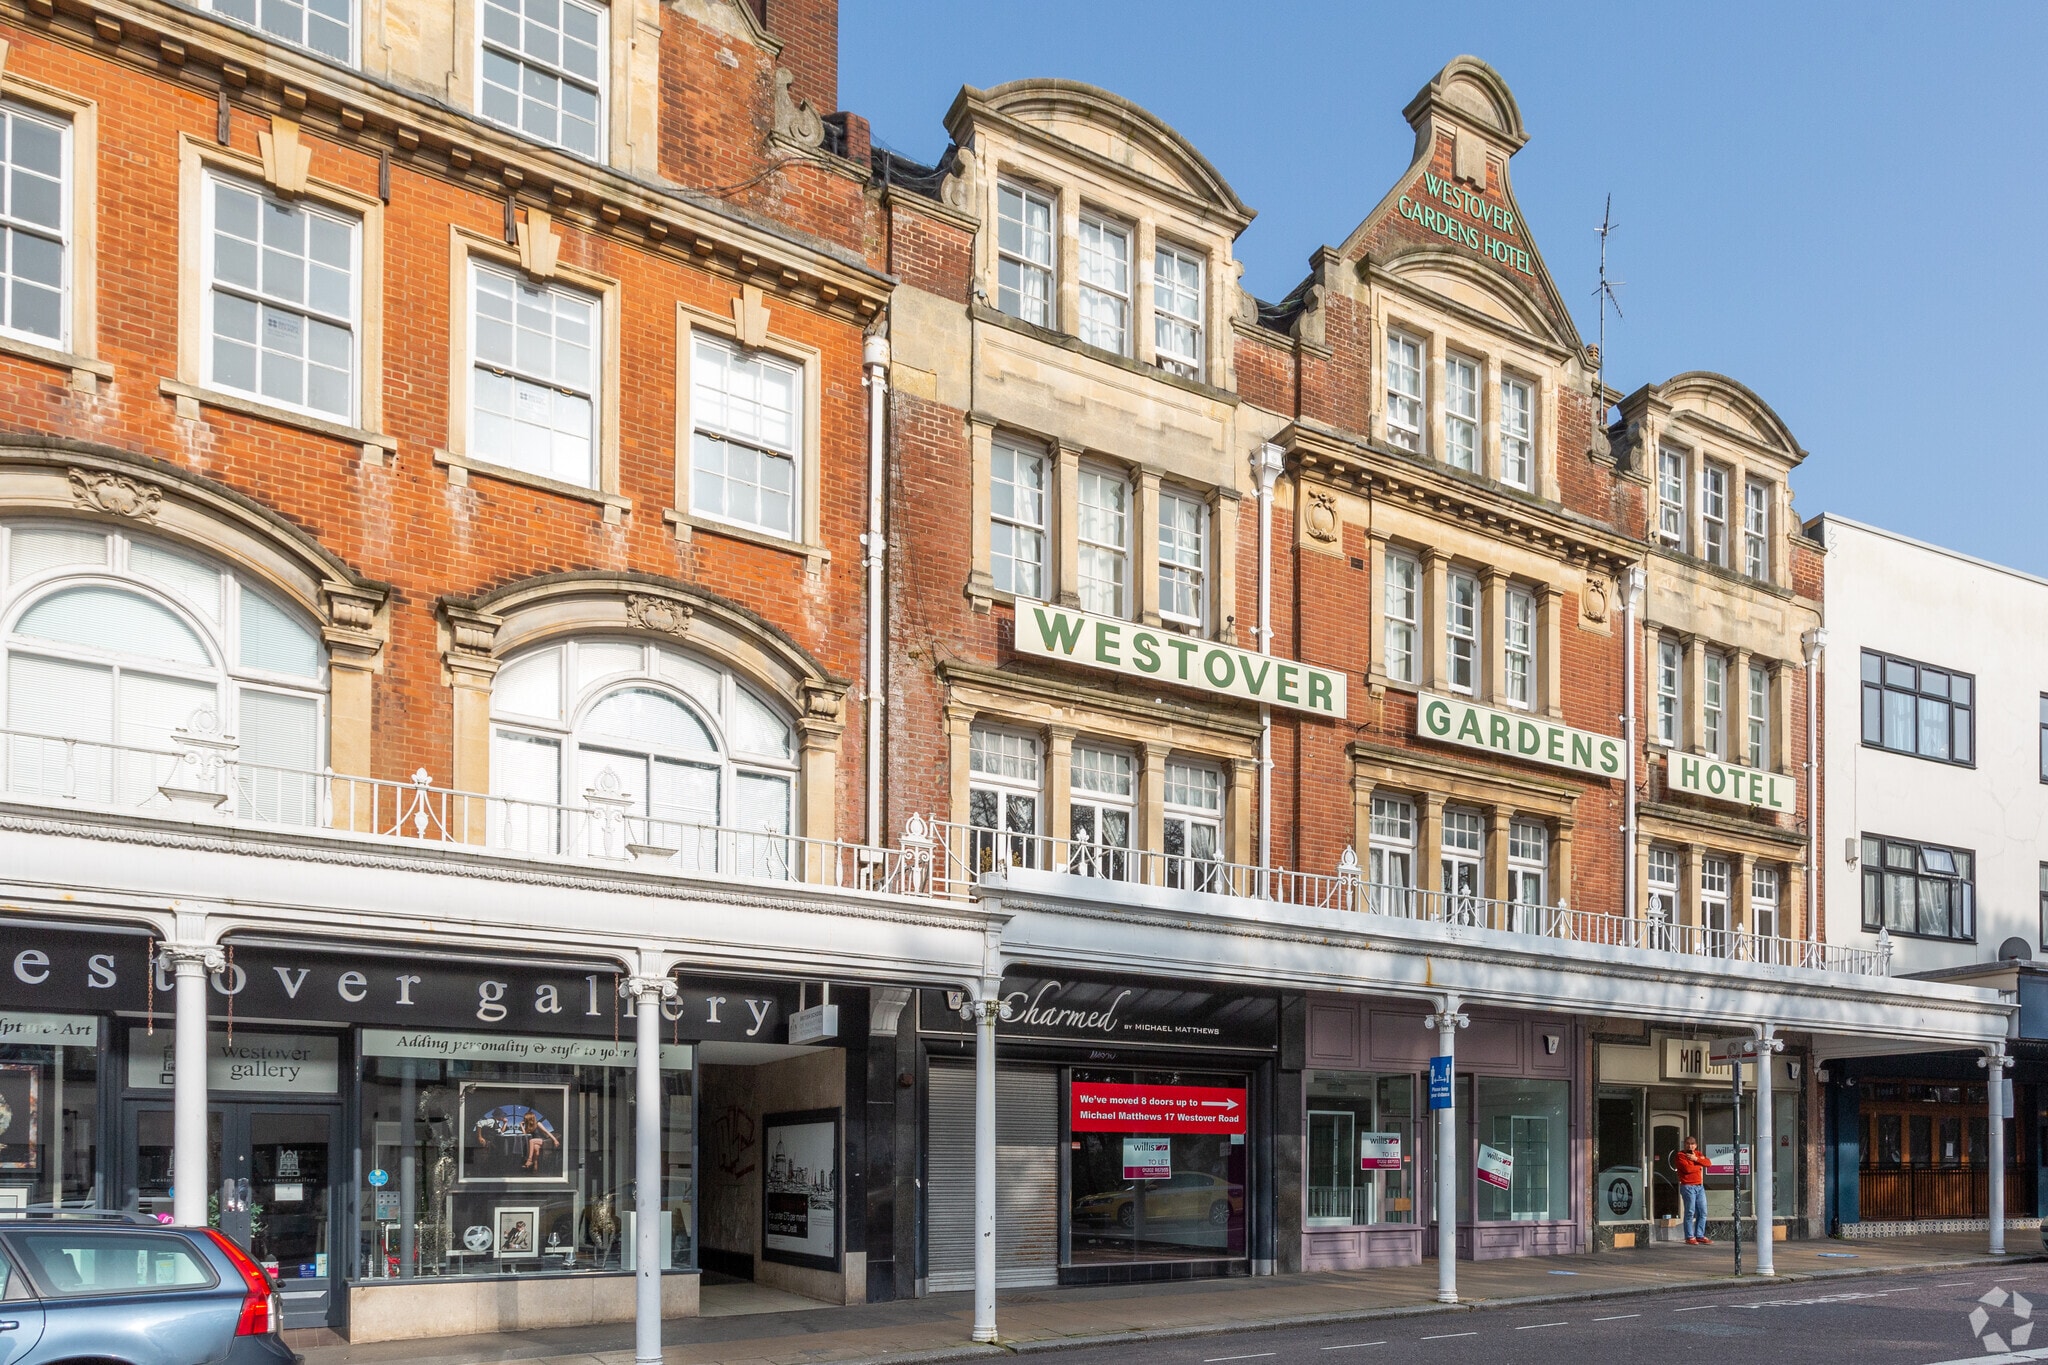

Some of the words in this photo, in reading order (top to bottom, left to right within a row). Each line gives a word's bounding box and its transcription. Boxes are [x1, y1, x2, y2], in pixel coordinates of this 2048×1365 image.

[1424, 171, 1514, 235] WESTOVER
[1398, 195, 1479, 250] GARDENS
[1484, 234, 1534, 277] HOTEL
[1033, 608, 1335, 711] WESTOVER
[1426, 699, 1619, 772] GARDENS
[1681, 757, 1782, 808] HOTEL
[1001, 981, 1132, 1032] Charmed
[1134, 1024, 1173, 1033] MICHAEL
[1175, 1026, 1220, 1035] MATTHEWS
[59, 1023, 92, 1036] Art
[221, 1046, 311, 1061] westover
[396, 1035, 449, 1054] Adding
[230, 1061, 301, 1082] gallery
[1680, 1048, 1702, 1074] MIA
[1080, 1094, 1107, 1104] We've
[1109, 1096, 1139, 1105] moved
[1141, 1097, 1147, 1105] 8
[1149, 1097, 1174, 1106] doors
[1176, 1100, 1187, 1108] up
[1189, 1099, 1198, 1107] to
[1080, 1110, 1116, 1120] Michael
[1118, 1111, 1162, 1121] Matthews
[1164, 1113, 1175, 1121] 17
[1177, 1114, 1216, 1122] Westover
[1218, 1115, 1239, 1123] Road
[1134, 1141, 1155, 1151] willis
[1370, 1135, 1388, 1145] willis
